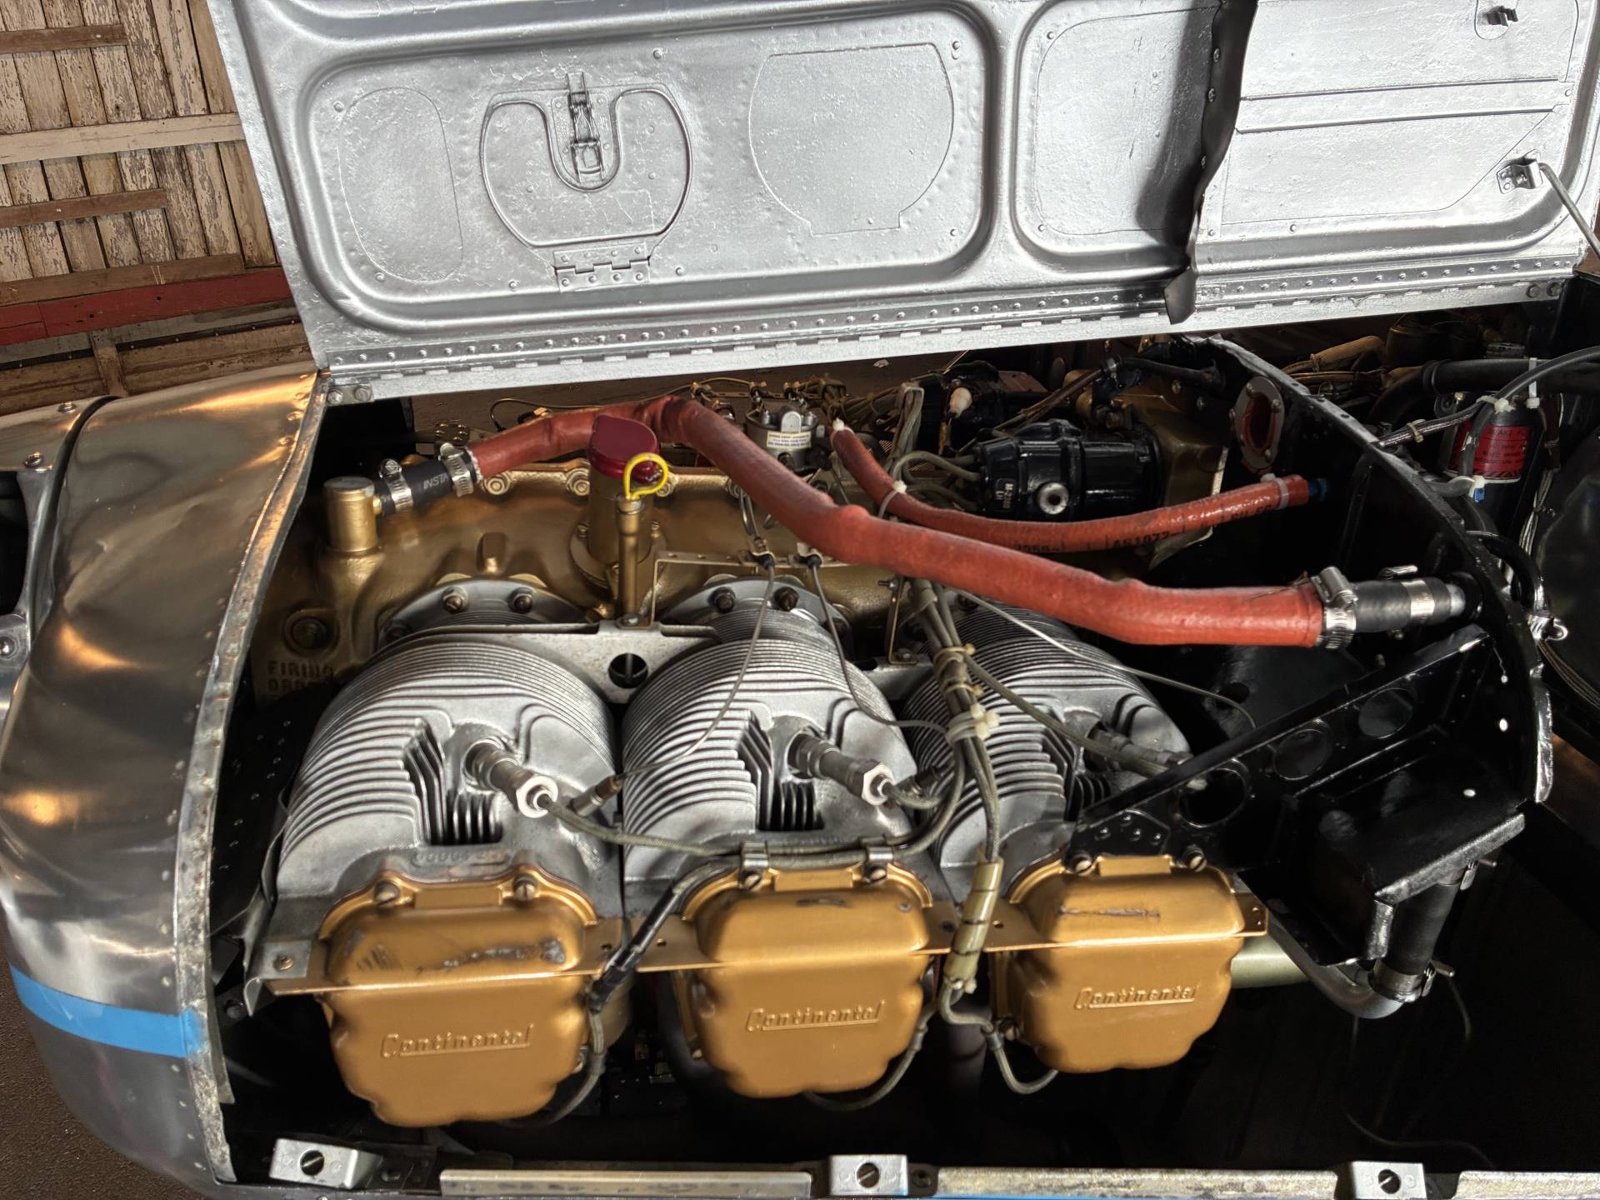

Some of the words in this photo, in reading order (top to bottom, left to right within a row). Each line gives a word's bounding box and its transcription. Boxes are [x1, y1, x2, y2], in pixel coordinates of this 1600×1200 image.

[1073, 983, 1200, 1010] Continental
[746, 1000, 886, 1031] Continental
[381, 1024, 534, 1058] Continental
